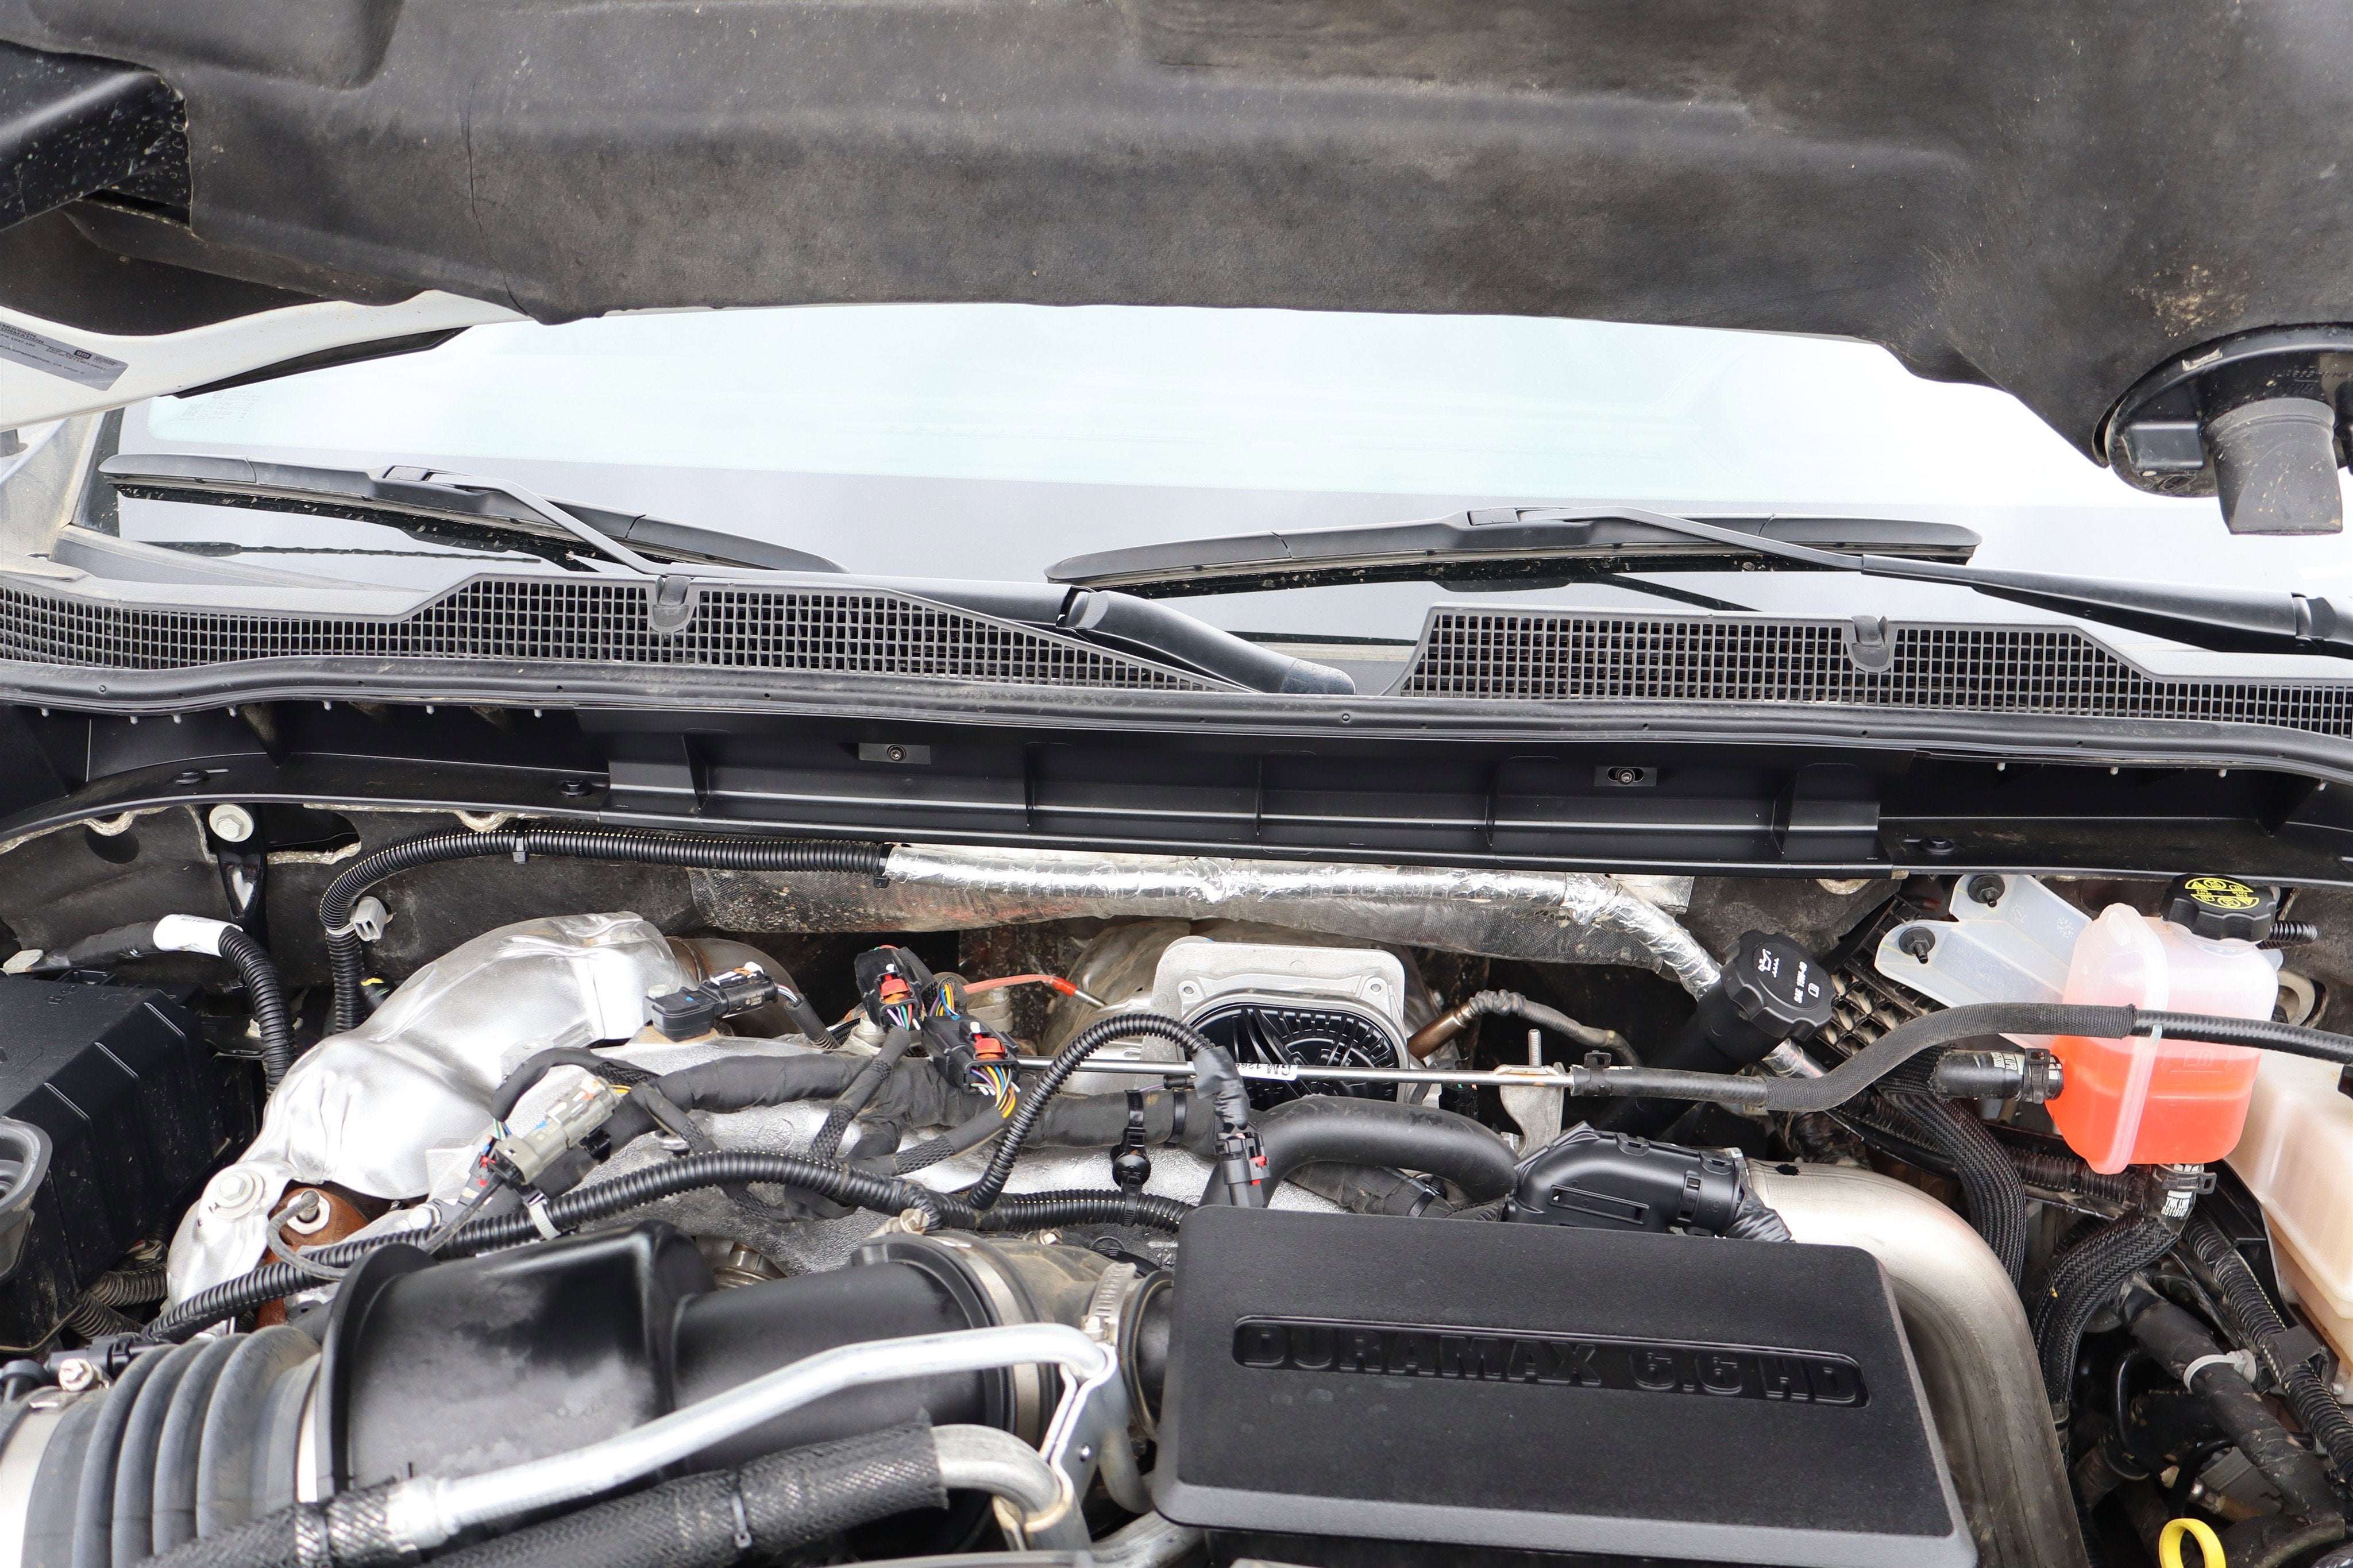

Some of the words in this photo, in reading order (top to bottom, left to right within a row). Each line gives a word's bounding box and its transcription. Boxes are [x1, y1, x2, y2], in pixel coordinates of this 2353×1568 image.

[1793, 987, 1804, 1004] SAE
[1243, 1324, 1603, 1387] DURAMAX
[1628, 1346, 1743, 1396] 6.6
[1757, 1354, 1856, 1405] HD
